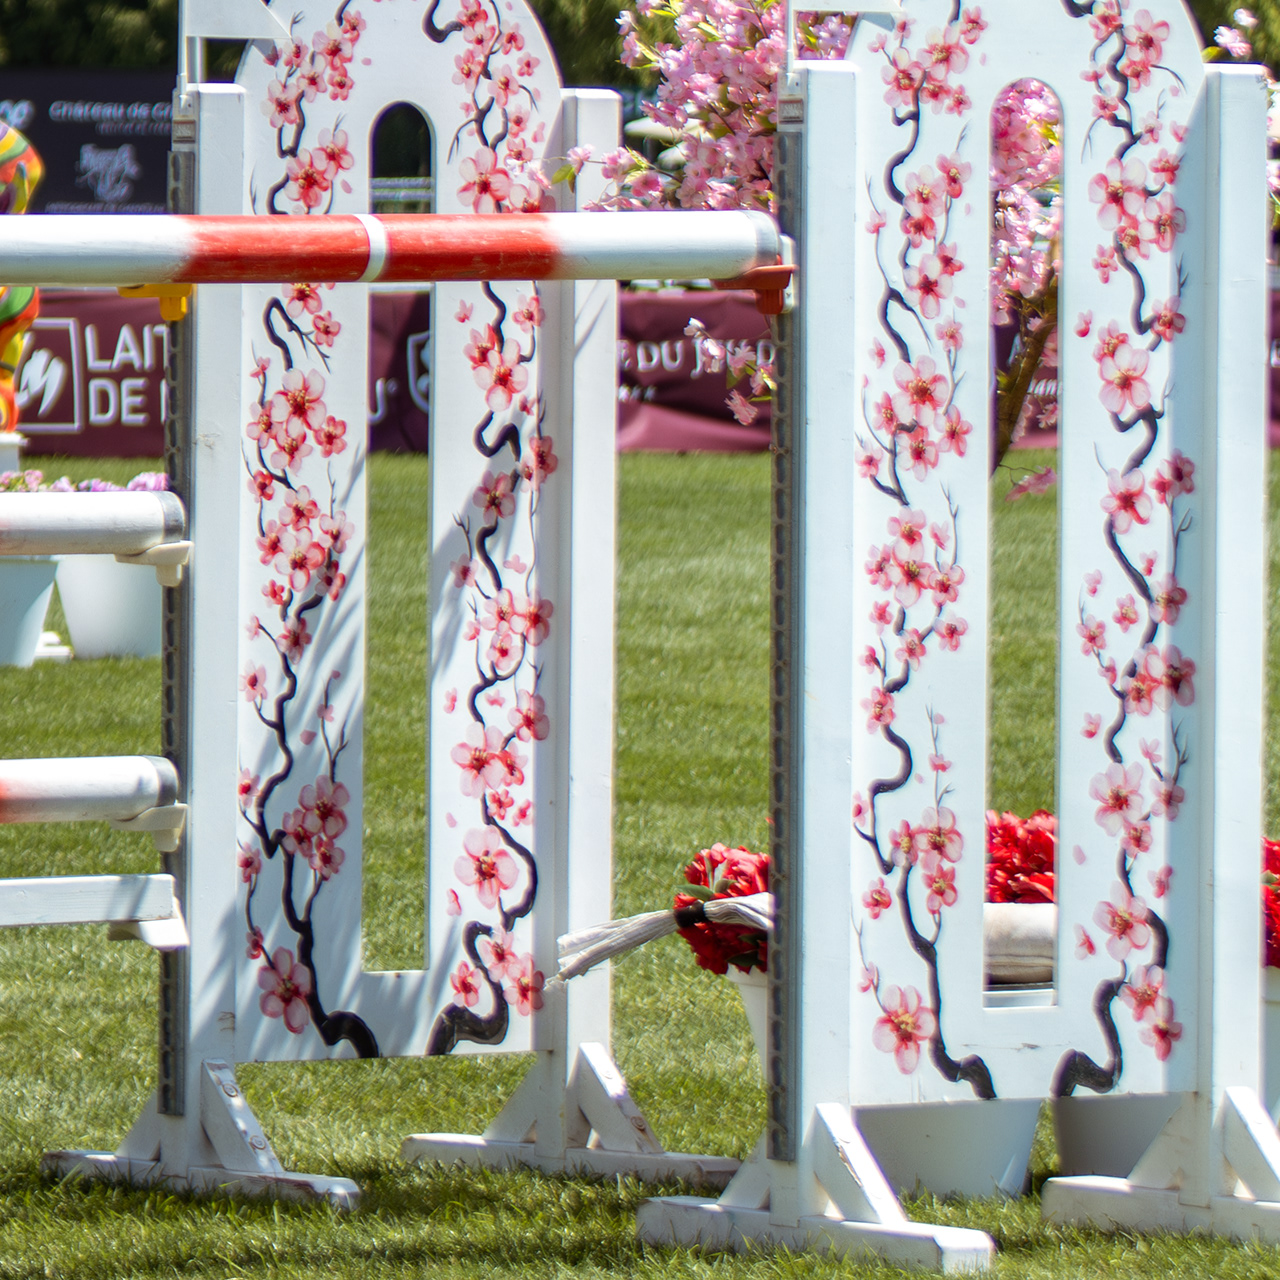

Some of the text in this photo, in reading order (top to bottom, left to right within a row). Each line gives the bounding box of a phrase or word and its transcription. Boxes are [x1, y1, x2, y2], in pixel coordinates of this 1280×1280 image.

[85, 324, 171, 372] LAIT
[638, 341, 684, 372] DU
[89, 378, 148, 426] DE
